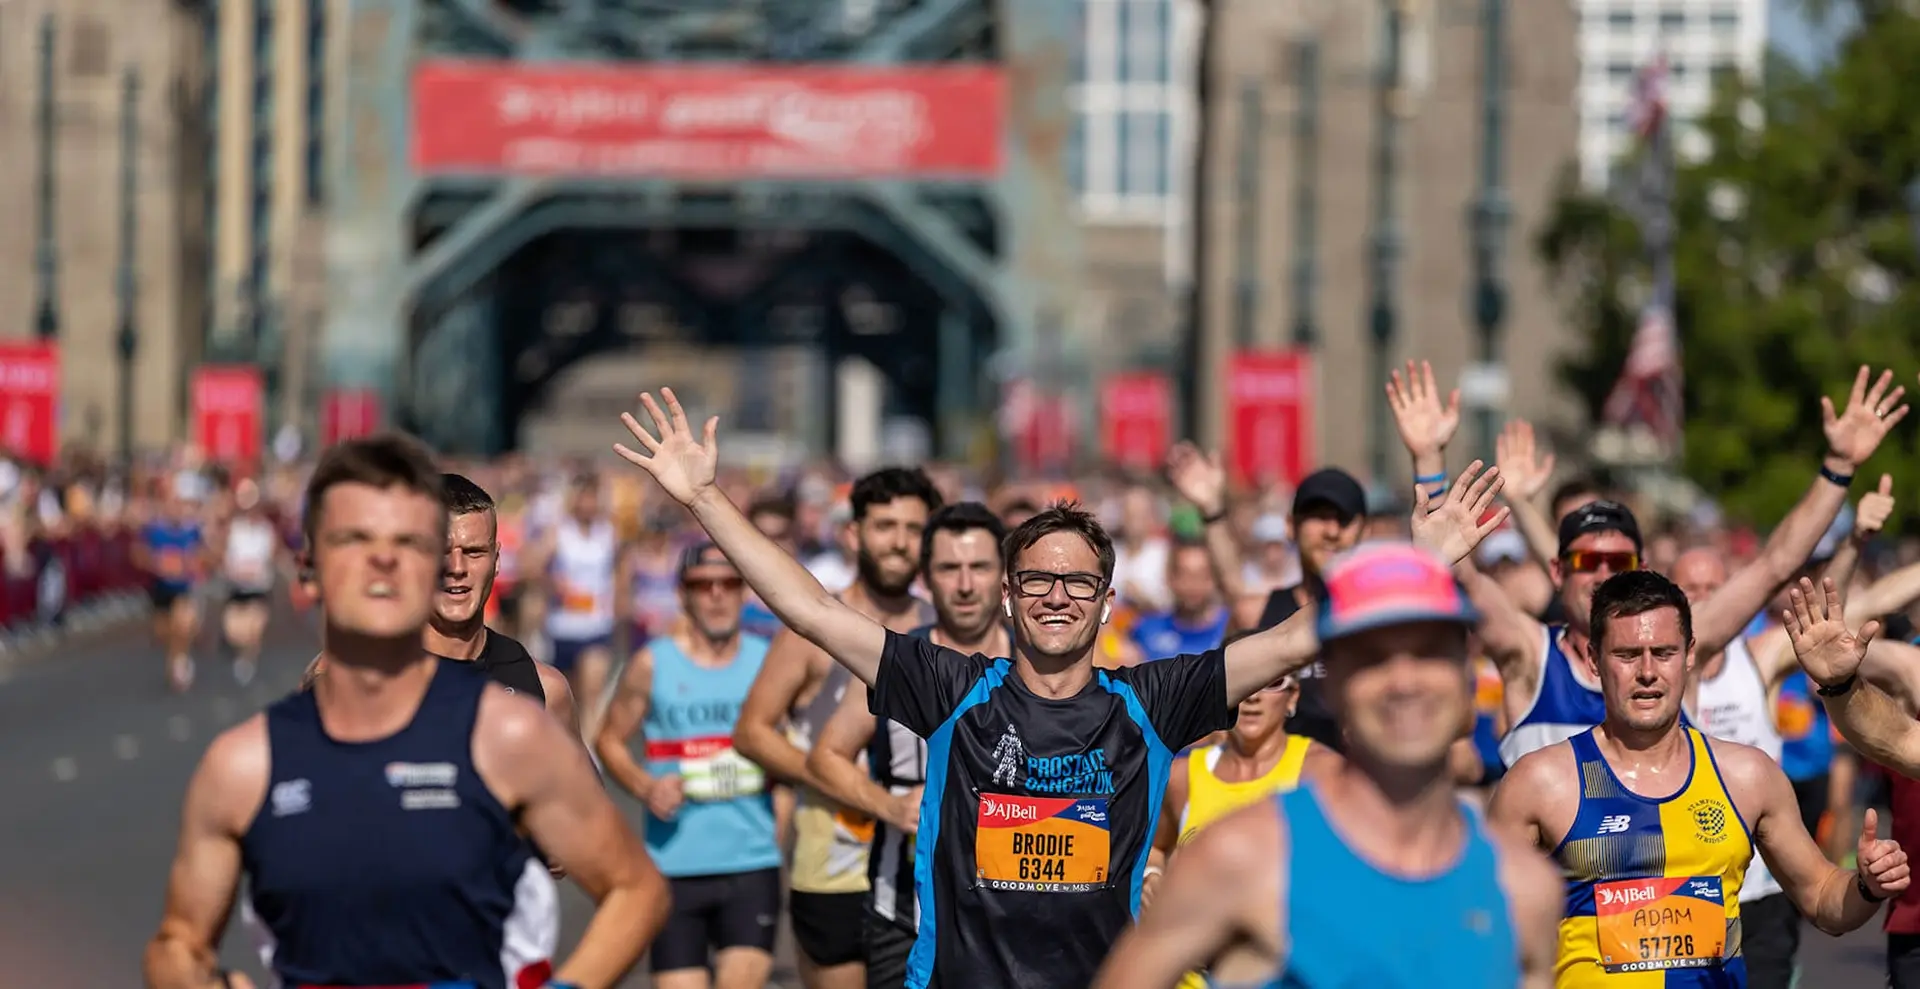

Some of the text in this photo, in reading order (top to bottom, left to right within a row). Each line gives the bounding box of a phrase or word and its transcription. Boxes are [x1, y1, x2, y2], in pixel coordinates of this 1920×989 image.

[1026, 748, 1107, 779] PROSTATE
[1095, 770, 1115, 794] UK
[1687, 799, 1726, 811] STAMFORD
[1013, 832, 1074, 856] BRODIE
[1695, 833, 1727, 843] STRIDERS
[1019, 858, 1065, 880] 6344
[992, 881, 1059, 891] GOODMOVE
[1633, 908, 1692, 927] ADAM
[1639, 935, 1694, 959] 57726
[1622, 958, 1686, 971] GOODMOVE
